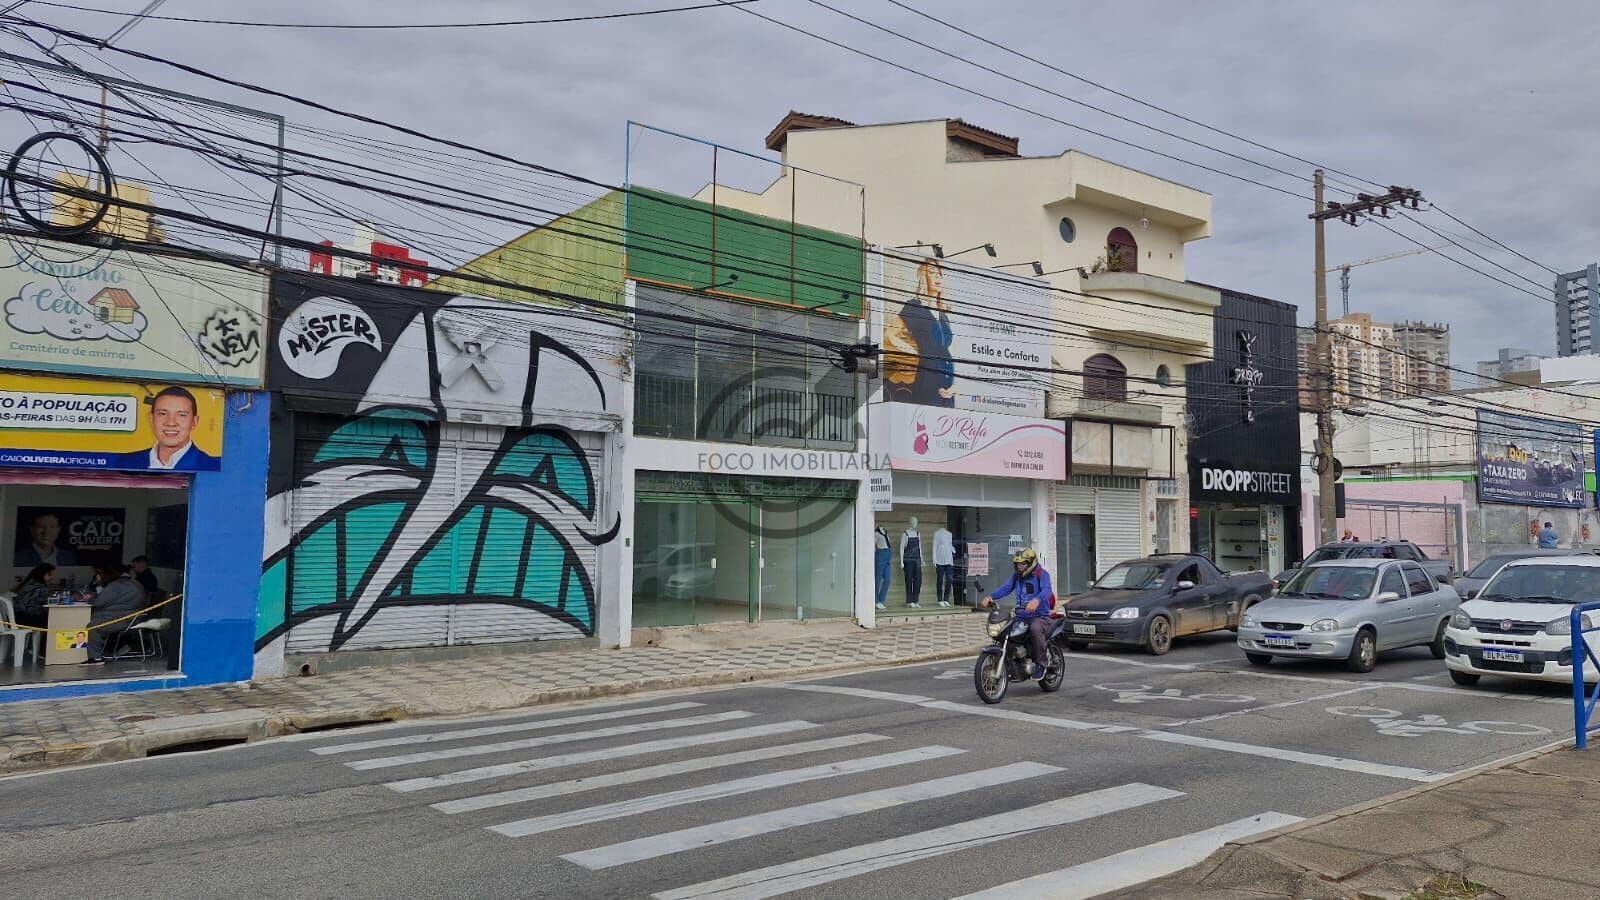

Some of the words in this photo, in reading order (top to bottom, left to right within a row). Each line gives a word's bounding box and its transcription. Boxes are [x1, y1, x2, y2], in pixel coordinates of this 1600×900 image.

[31, 288, 84, 315] Céu
[10, 341, 69, 356] Cemitério
[71, 347, 86, 357] de
[88, 349, 136, 361] animais
[971, 343, 995, 356] Estilo
[996, 349, 1002, 357] e
[1004, 348, 1040, 363] Conforto
[17, 396, 29, 409] À
[32, 399, 127, 414] POPULAÇÃO
[55, 414, 76, 422] DAS
[78, 415, 92, 423] 9H
[109, 416, 127, 425] 17H
[1201, 467, 1292, 494] DROPPSTREET
[1508, 466, 1527, 480] ZERO
[69, 536, 121, 545] OLIVEIRA
